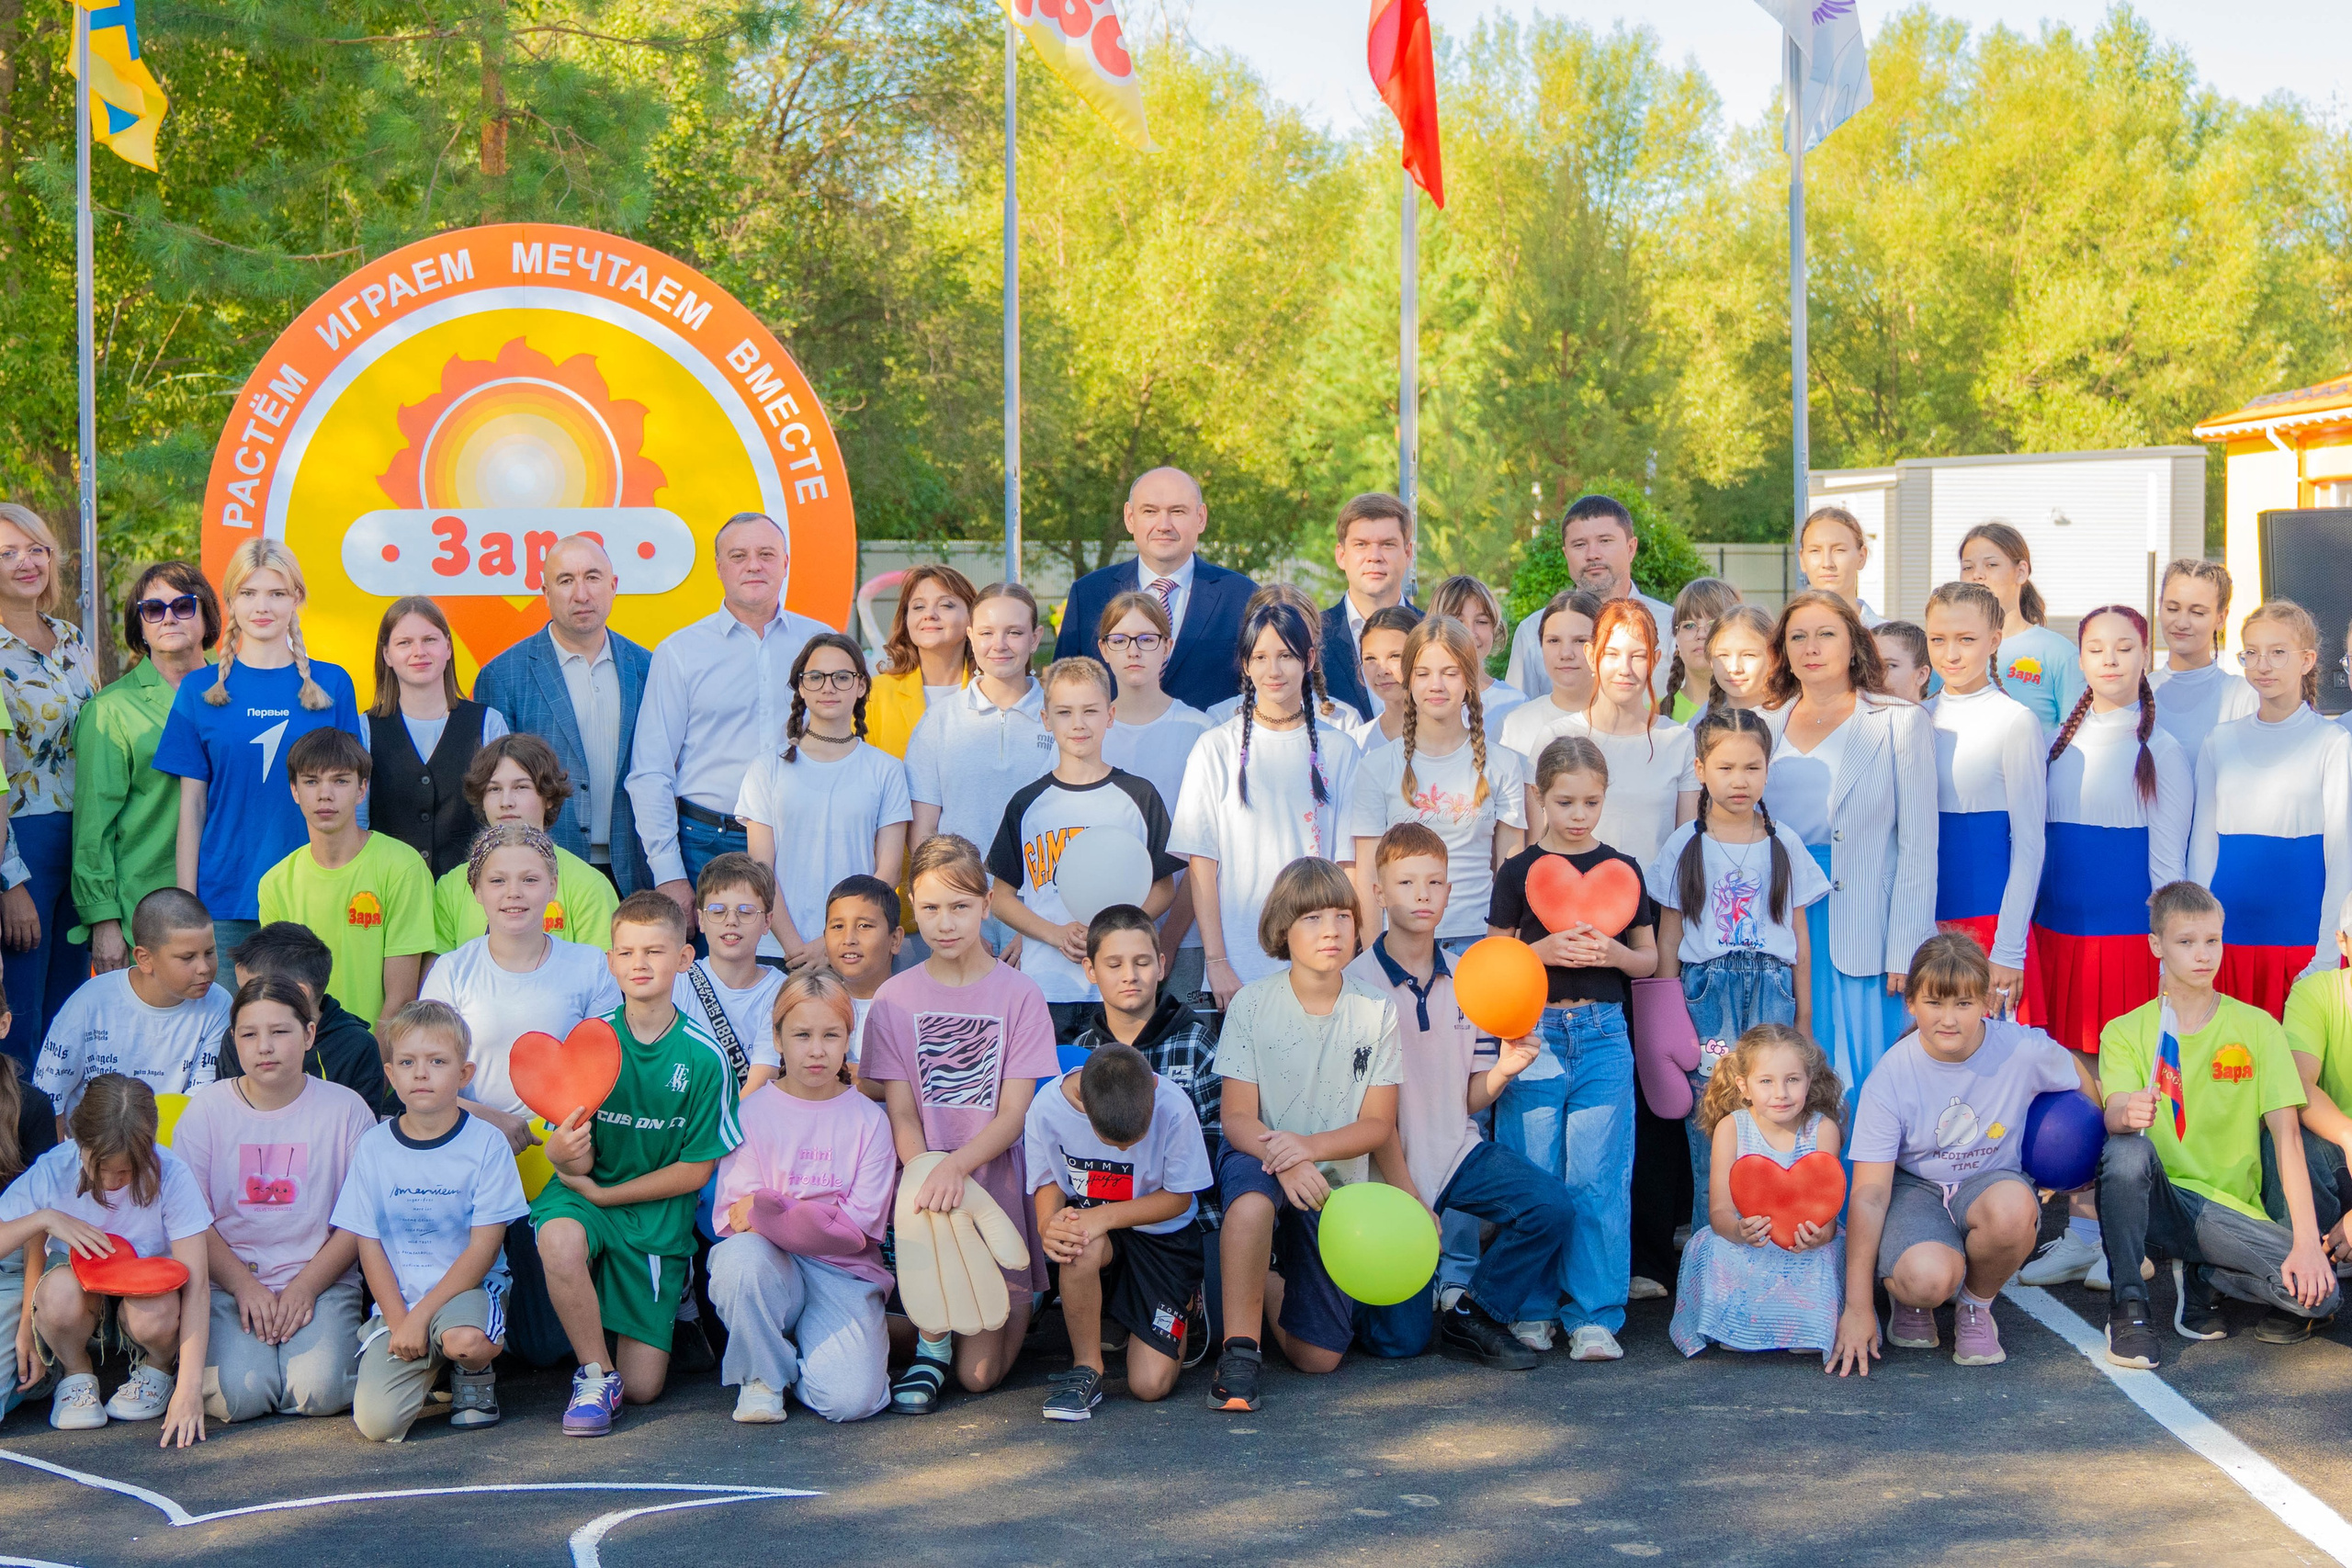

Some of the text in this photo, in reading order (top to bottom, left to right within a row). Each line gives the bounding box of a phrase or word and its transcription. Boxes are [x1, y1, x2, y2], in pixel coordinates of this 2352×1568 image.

[221, 243, 829, 529] РАСТЁМ ИГРАЕМ МЕЧТАЕМ ВМЕСТЕ
[431, 516, 605, 591] Зар
[2007, 666, 2041, 685] Заря
[247, 707, 289, 719] Первые
[349, 908, 381, 929] Заря
[543, 917, 563, 932] ря
[2212, 1062, 2254, 1084] Заря
[596, 1109, 633, 1126] CUS
[635, 1117, 665, 1130] ON
[799, 1145, 832, 1162] mini
[1932, 1145, 2000, 1160] MEDITATION
[1068, 1157, 1129, 1174] OMMY
[1951, 1161, 1980, 1171] TIME
[788, 1170, 843, 1188] trouble
